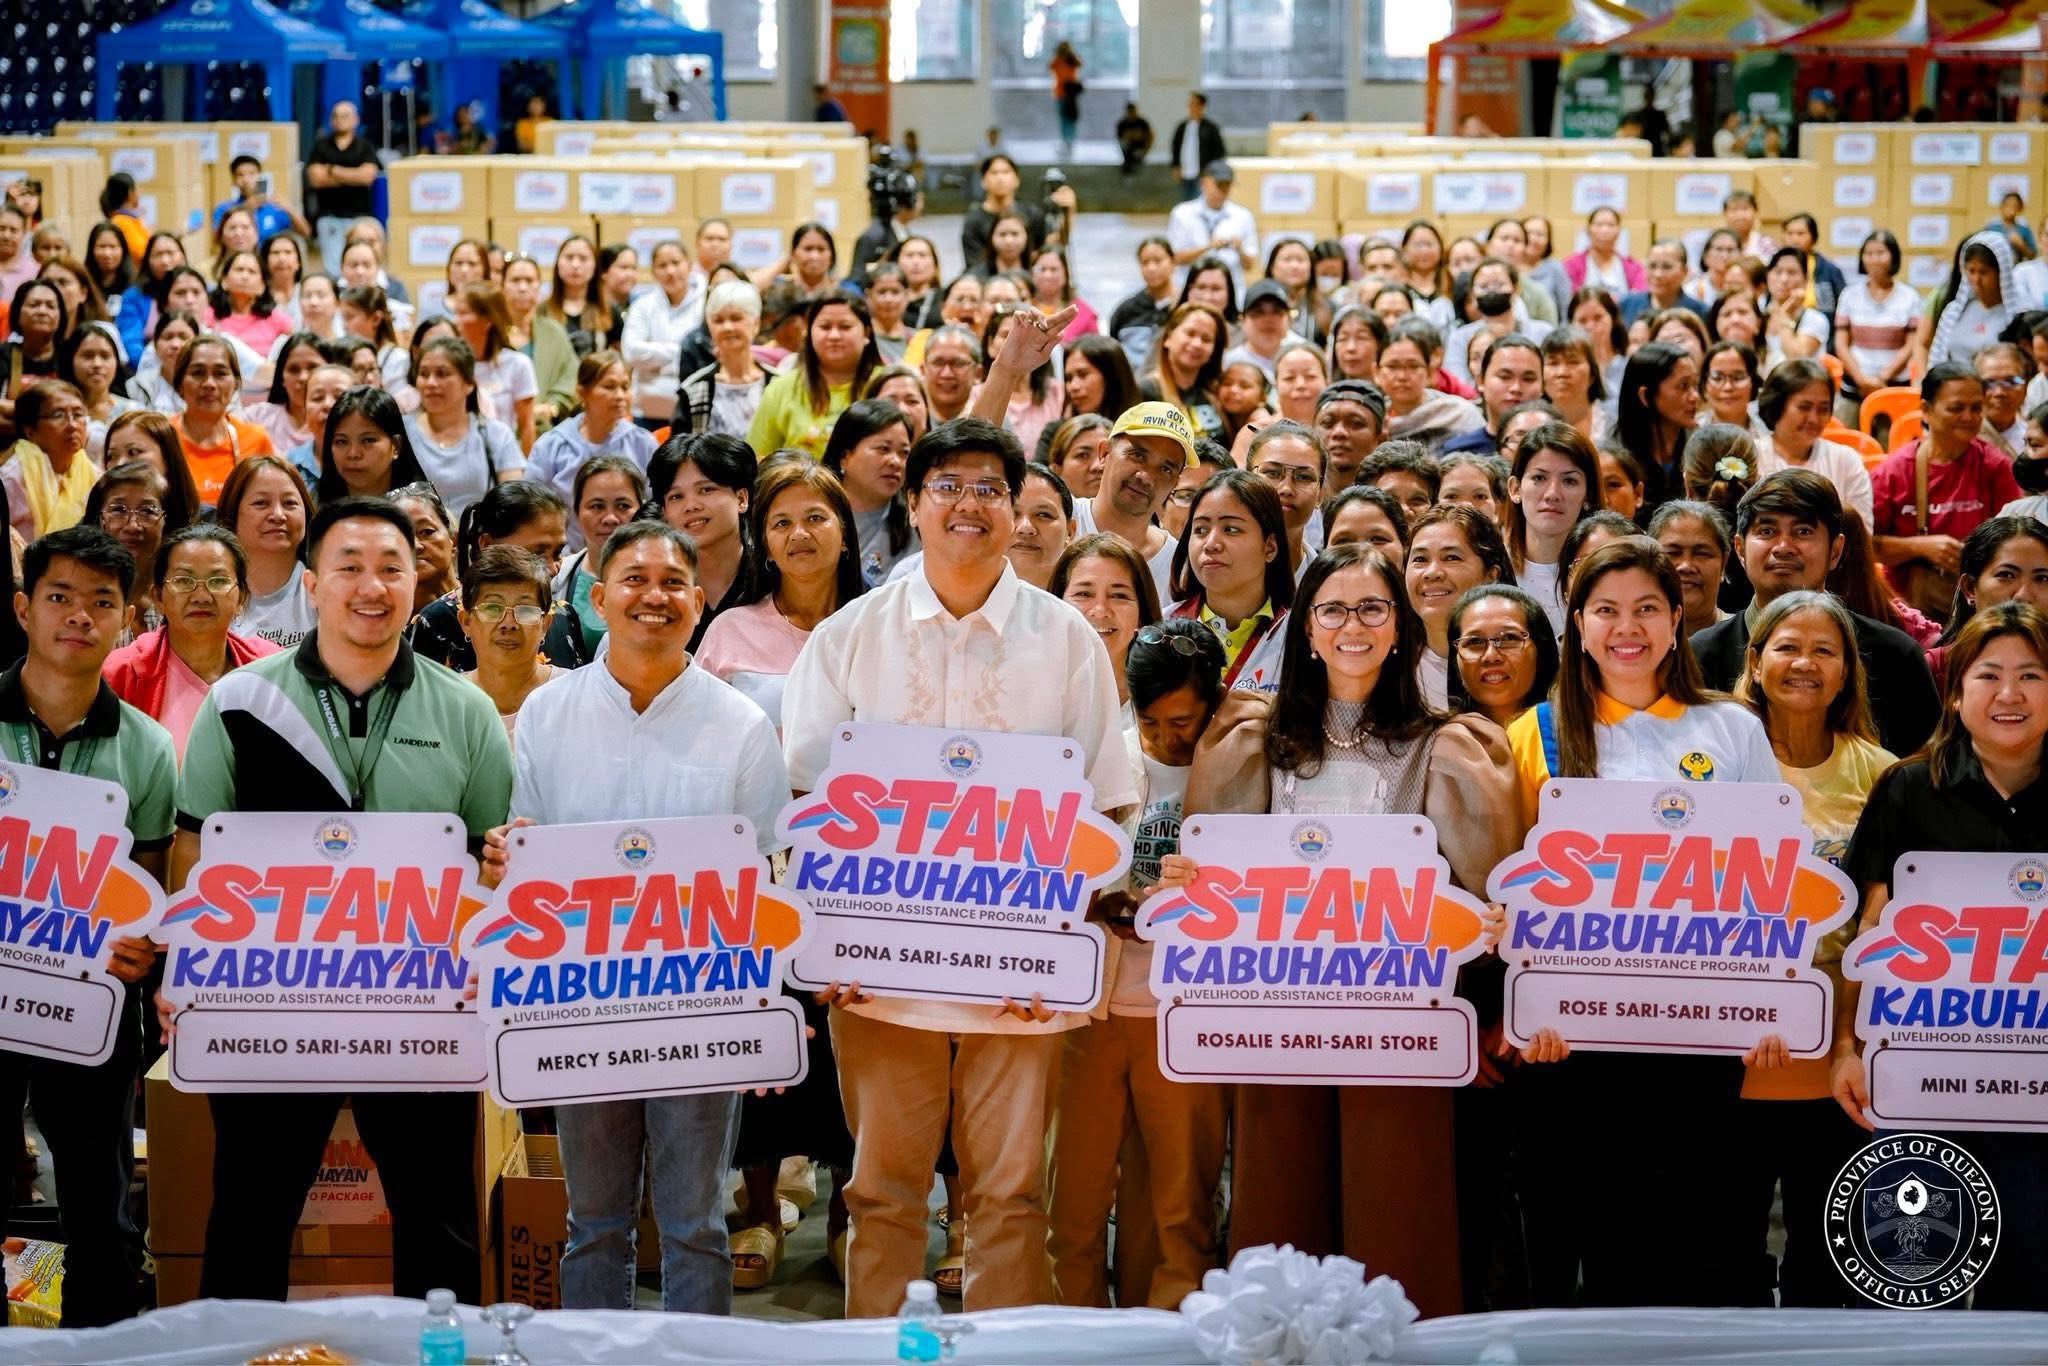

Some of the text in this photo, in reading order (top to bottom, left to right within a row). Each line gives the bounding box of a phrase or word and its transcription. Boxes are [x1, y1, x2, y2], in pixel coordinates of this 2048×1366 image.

[1143, 416, 1167, 427] IRVIN
[320, 697, 341, 739] LANDBANK
[393, 737, 441, 749] LANDBANK
[817, 773, 1082, 866] STAN
[796, 851, 1085, 912] KABUHAYAN
[1530, 830, 1801, 914] STAN
[191, 863, 464, 944] STAN
[504, 867, 758, 960] STAN
[816, 896, 1047, 925] LIVELIHOOD ASSISTANCE PROGRAM
[1177, 866, 1437, 943] STAN
[0, 901, 112, 959] YAN
[1511, 910, 1808, 959] KABUHAYAN
[172, 947, 469, 989] KABUHAYAN
[835, 943, 1056, 975] DONA SARI-SARI STORE
[1162, 945, 1450, 987] KABUHAYAN
[1533, 955, 1770, 974] LIVELIHOOD ASSISTANCE PROGRAM
[491, 948, 773, 1008] KABUHAYAN
[14, 998, 75, 1022] STORE
[195, 992, 435, 1005] LIVELIHOOD ASSISTANCE PROGRAM
[513, 995, 744, 1023] LIVELIHOOD ASSISTANCE PROGRAM
[1184, 989, 1414, 1002] LIVELIHOOD ASSISTANCE PROGRAM
[1559, 1000, 1778, 1022] ROSE SARI-SARI STORE
[1869, 986, 2048, 1029] KABUH
[206, 1038, 459, 1056] ANGELO SARI-SARI STORE
[1197, 1033, 1438, 1051] ROSALIE SARI-SARI STORE
[1891, 1032, 1971, 1043] LIVELIHOOD
[537, 1039, 763, 1072] MERCY SARI-SARI STORE
[1921, 1078, 1967, 1093] MINI
[320, 1191, 375, 1201] PACKAGE
